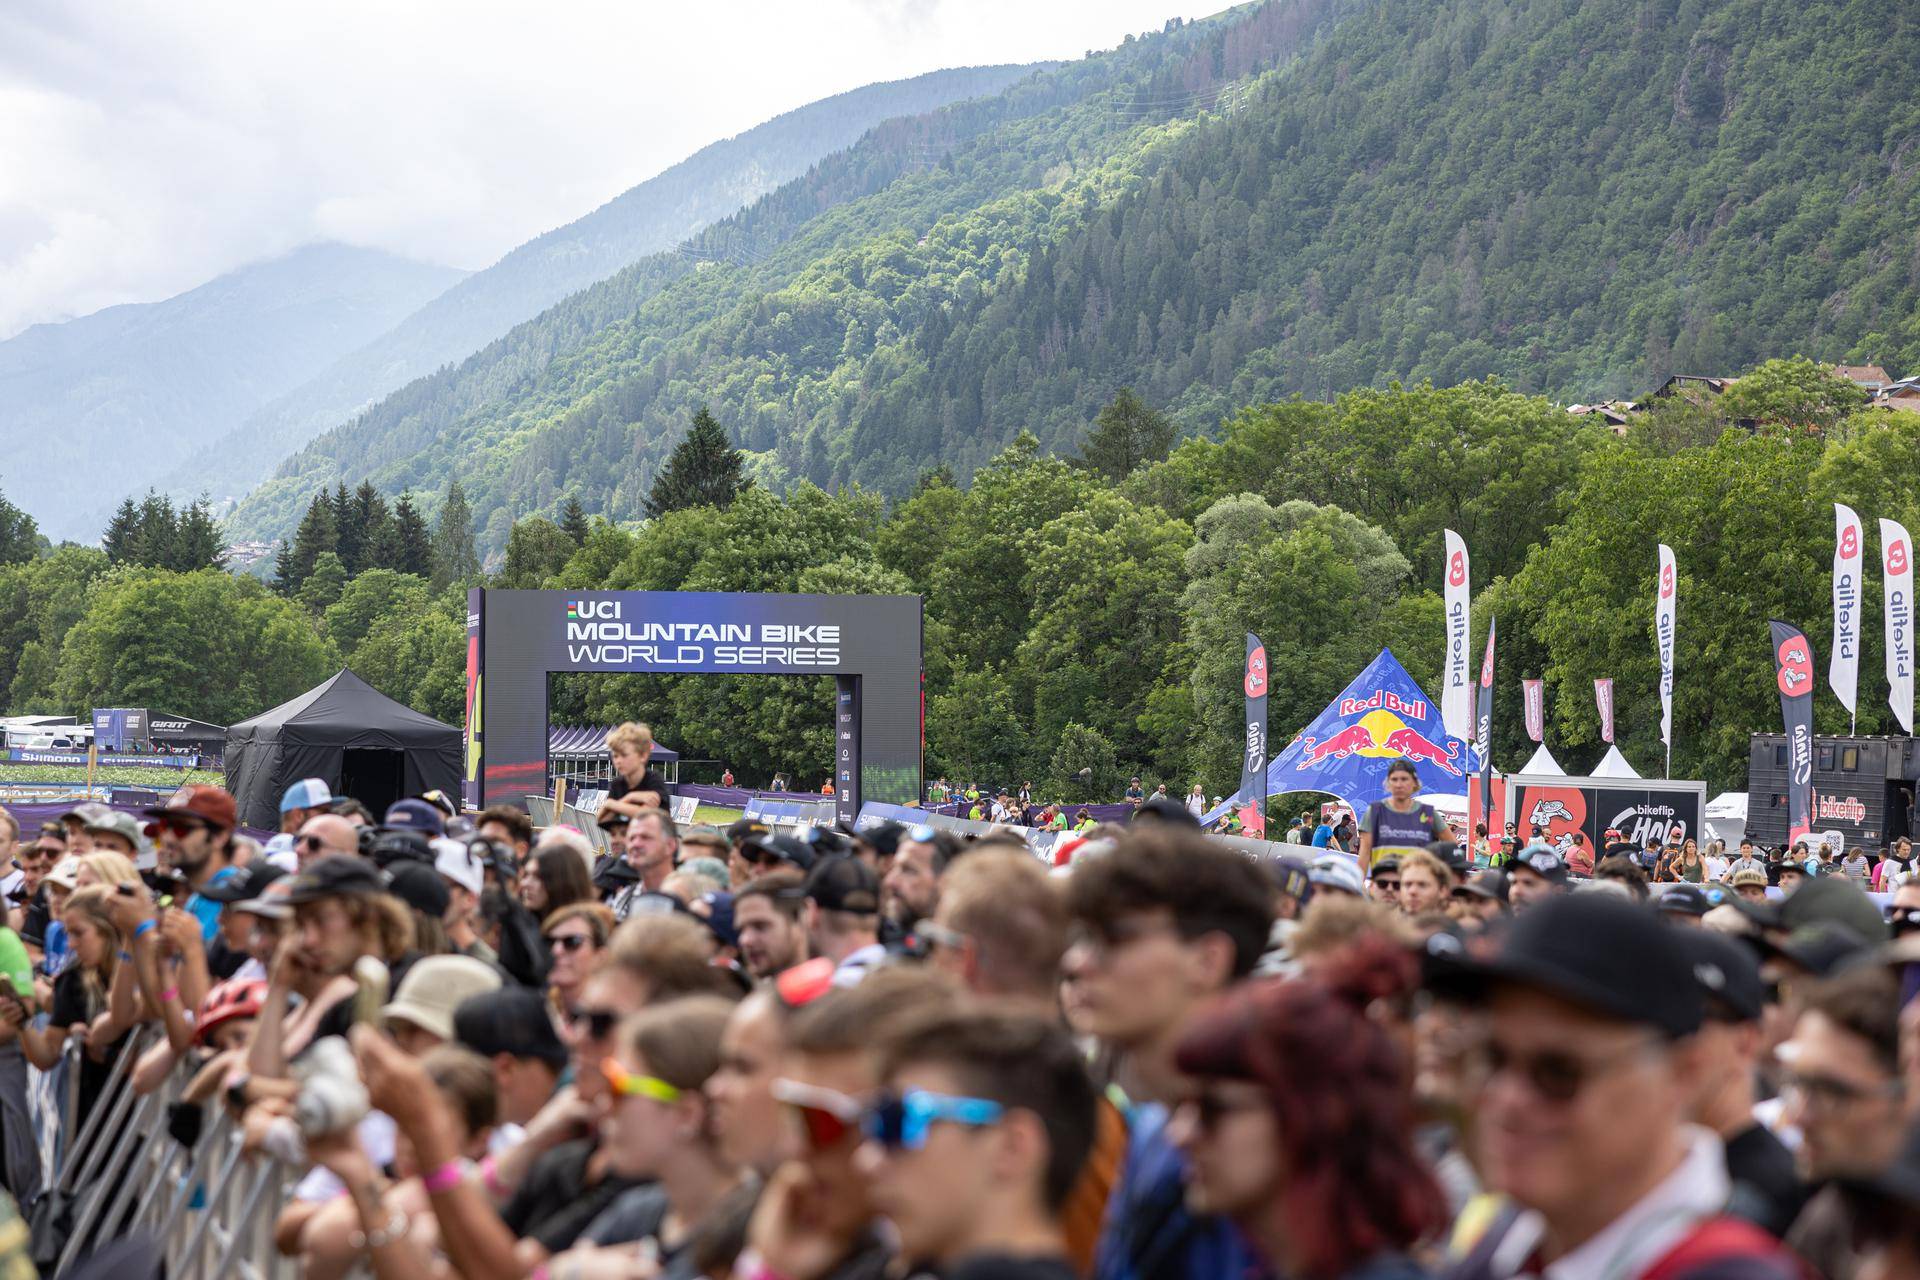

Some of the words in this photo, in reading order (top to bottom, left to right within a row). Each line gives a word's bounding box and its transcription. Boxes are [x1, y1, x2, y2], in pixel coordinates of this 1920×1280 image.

[577, 601, 621, 619] UCI
[568, 622, 752, 642] MOUNTAIN
[761, 625, 840, 643] BIKE
[568, 645, 704, 663] WORLD
[714, 646, 841, 665] SERIES
[1340, 690, 1382, 716] Red
[1385, 692, 1426, 720] Bull
[150, 721, 192, 729] GIANT
[21, 752, 81, 763] SHIMANO
[1637, 804, 1675, 818] bikeflip
[1820, 795, 1865, 826] bikeflip
